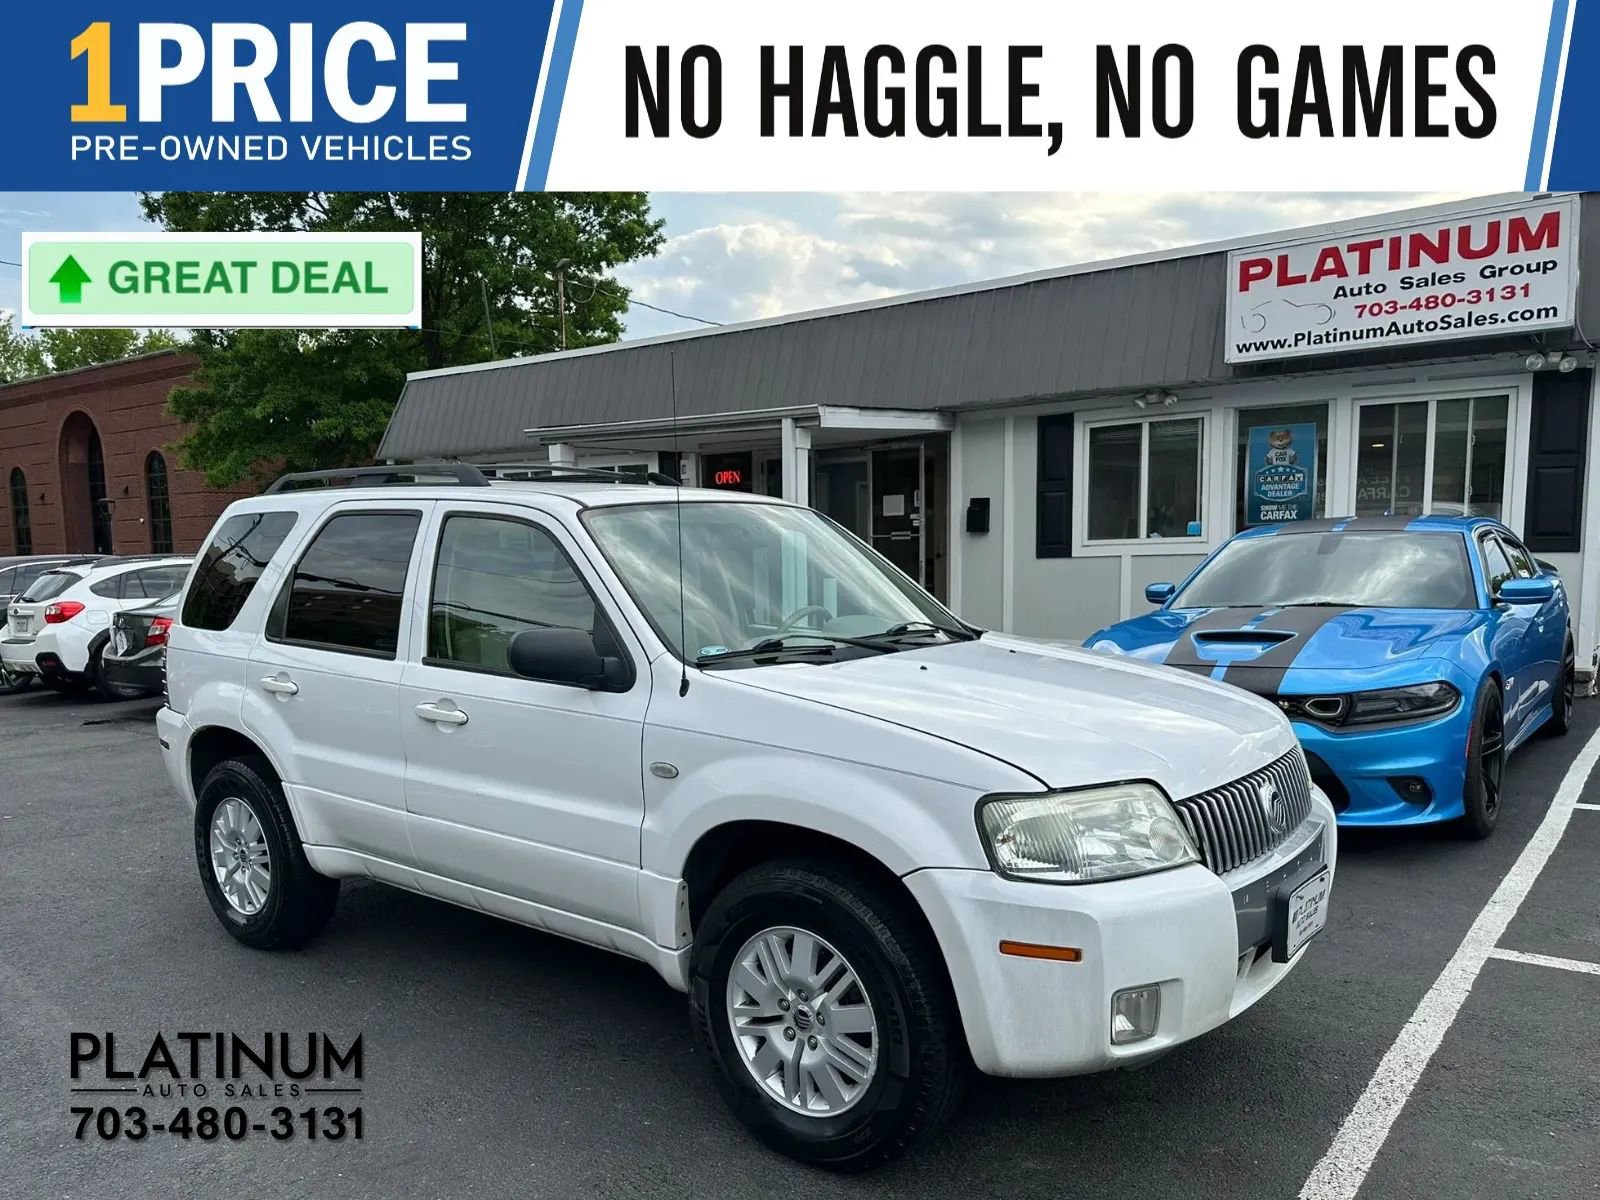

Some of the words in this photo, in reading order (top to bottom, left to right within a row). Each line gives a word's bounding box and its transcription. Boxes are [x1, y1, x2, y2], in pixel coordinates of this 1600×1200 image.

[1238, 211, 1561, 293] PLATINUM
[1333, 282, 1387, 300] Auto
[1399, 271, 1466, 291] Sales
[1479, 259, 1558, 280] Group
[1354, 283, 1531, 319] 703-480-3131
[1235, 305, 1558, 354] www.PlatinumAutoSales.com
[715, 470, 740, 485] OPEN
[1259, 473, 1304, 482] CARFAX
[1260, 483, 1300, 491] ADVANTAGE
[1267, 490, 1293, 498] DEALER
[1260, 510, 1298, 521] CARFAX
